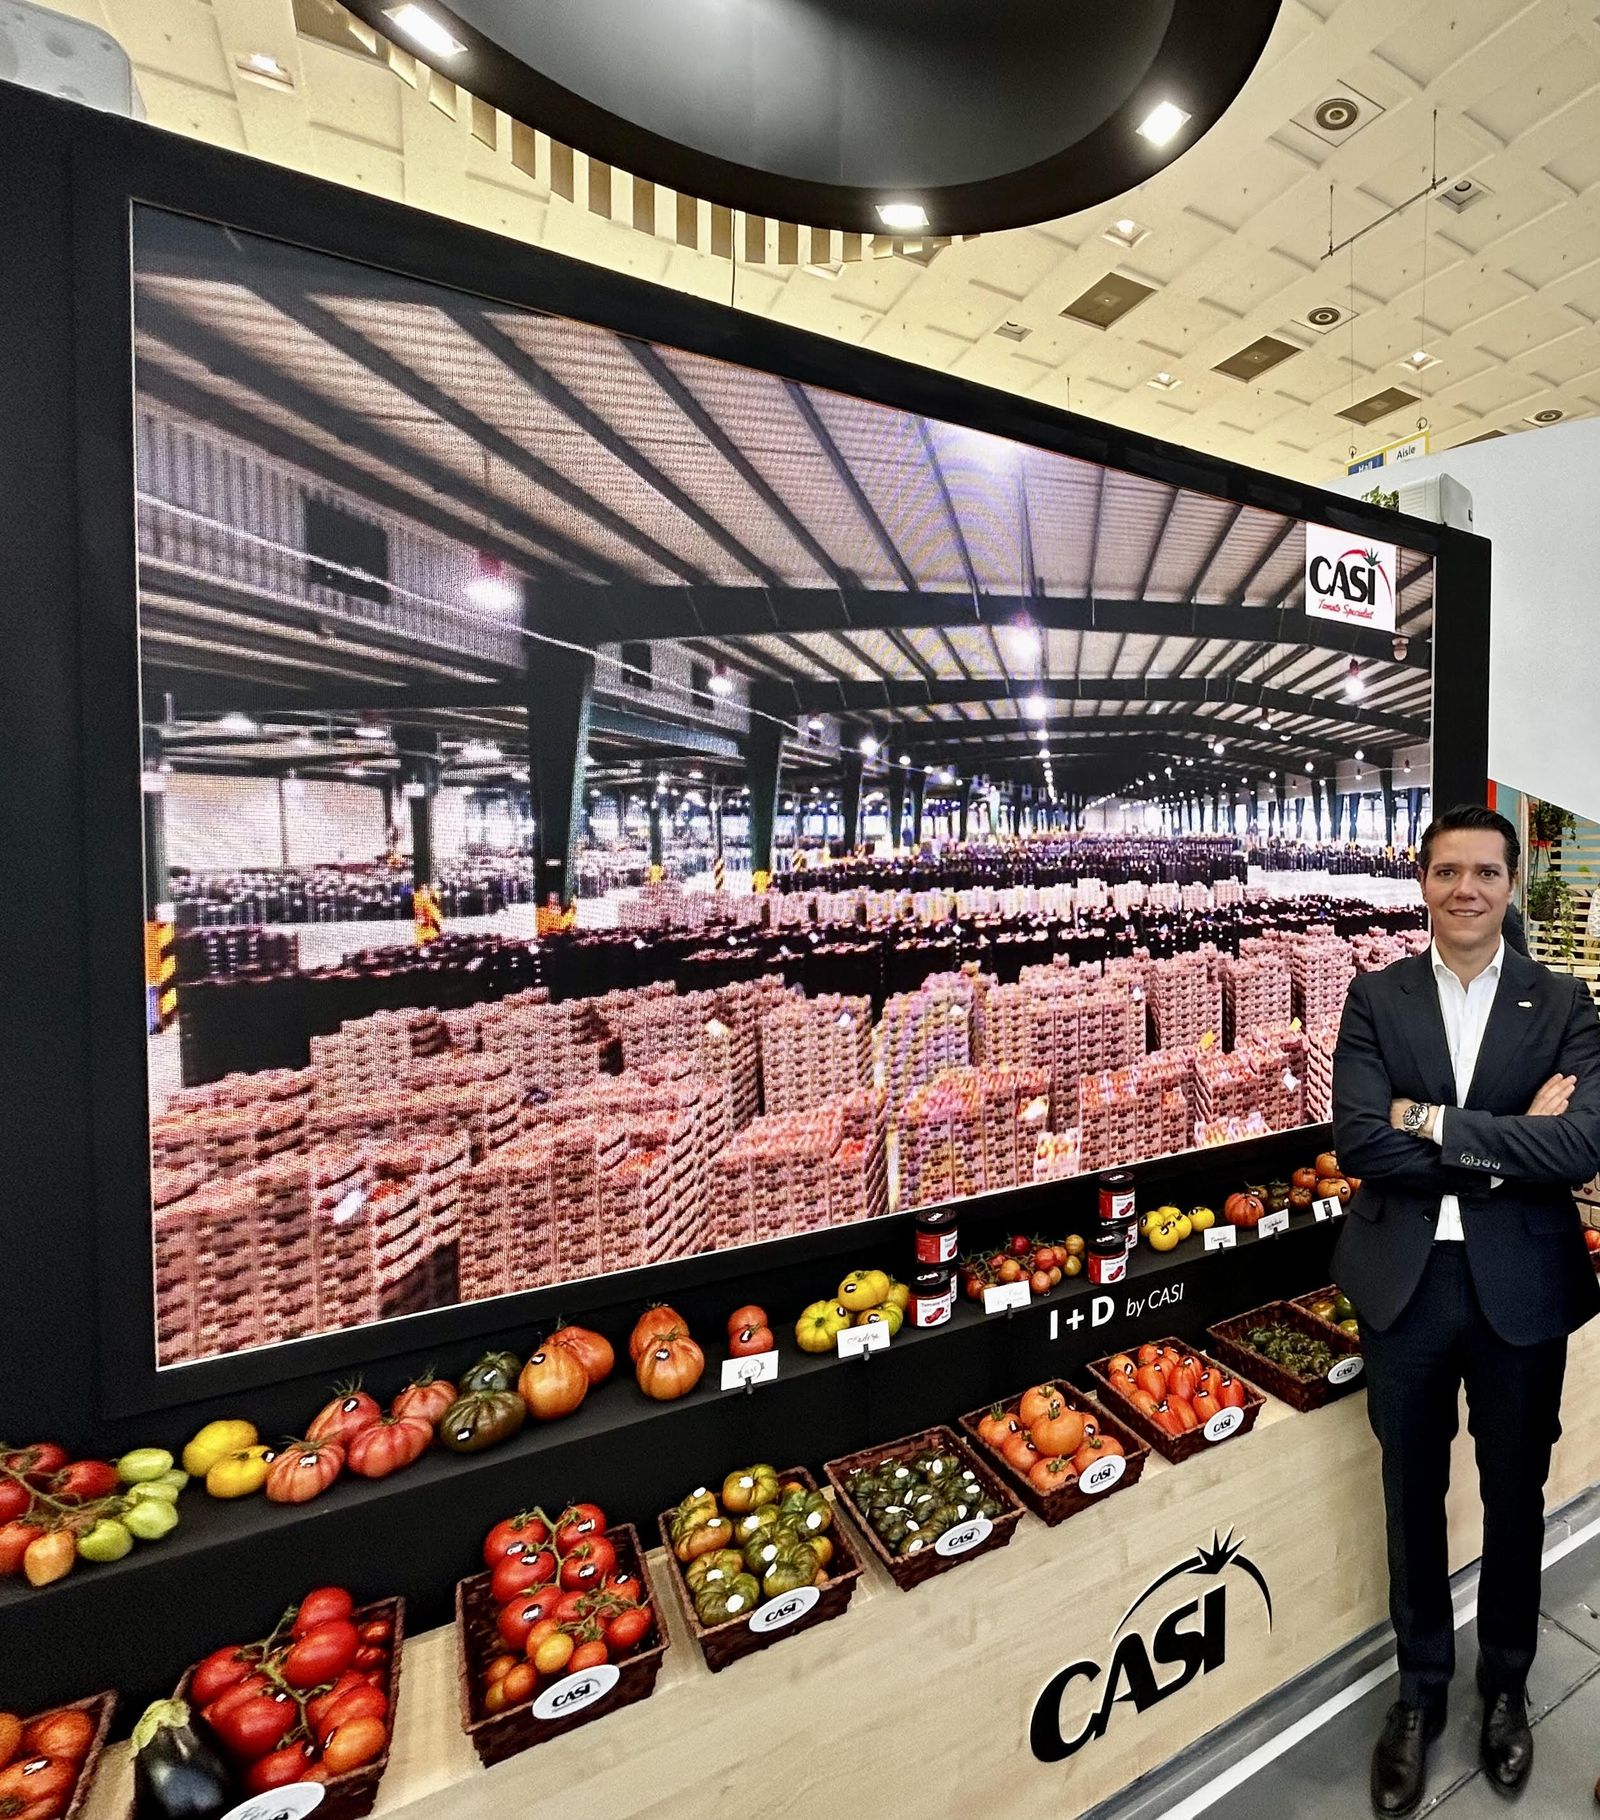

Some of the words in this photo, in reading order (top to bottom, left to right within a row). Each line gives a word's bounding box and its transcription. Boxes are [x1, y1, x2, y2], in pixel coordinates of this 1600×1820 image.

[1396, 445, 1416, 460] Aisle
[1309, 555, 1376, 606] CASI
[1126, 1298, 1145, 1317] by
[1148, 1282, 1184, 1309] CASI
[1213, 1418, 1231, 1433] CASI
[1090, 1467, 1111, 1484] CASI
[948, 1531, 975, 1547] CASI
[765, 1602, 797, 1622] CASI
[1030, 1583, 1226, 1763] CASI
[552, 1683, 591, 1707] CASI
